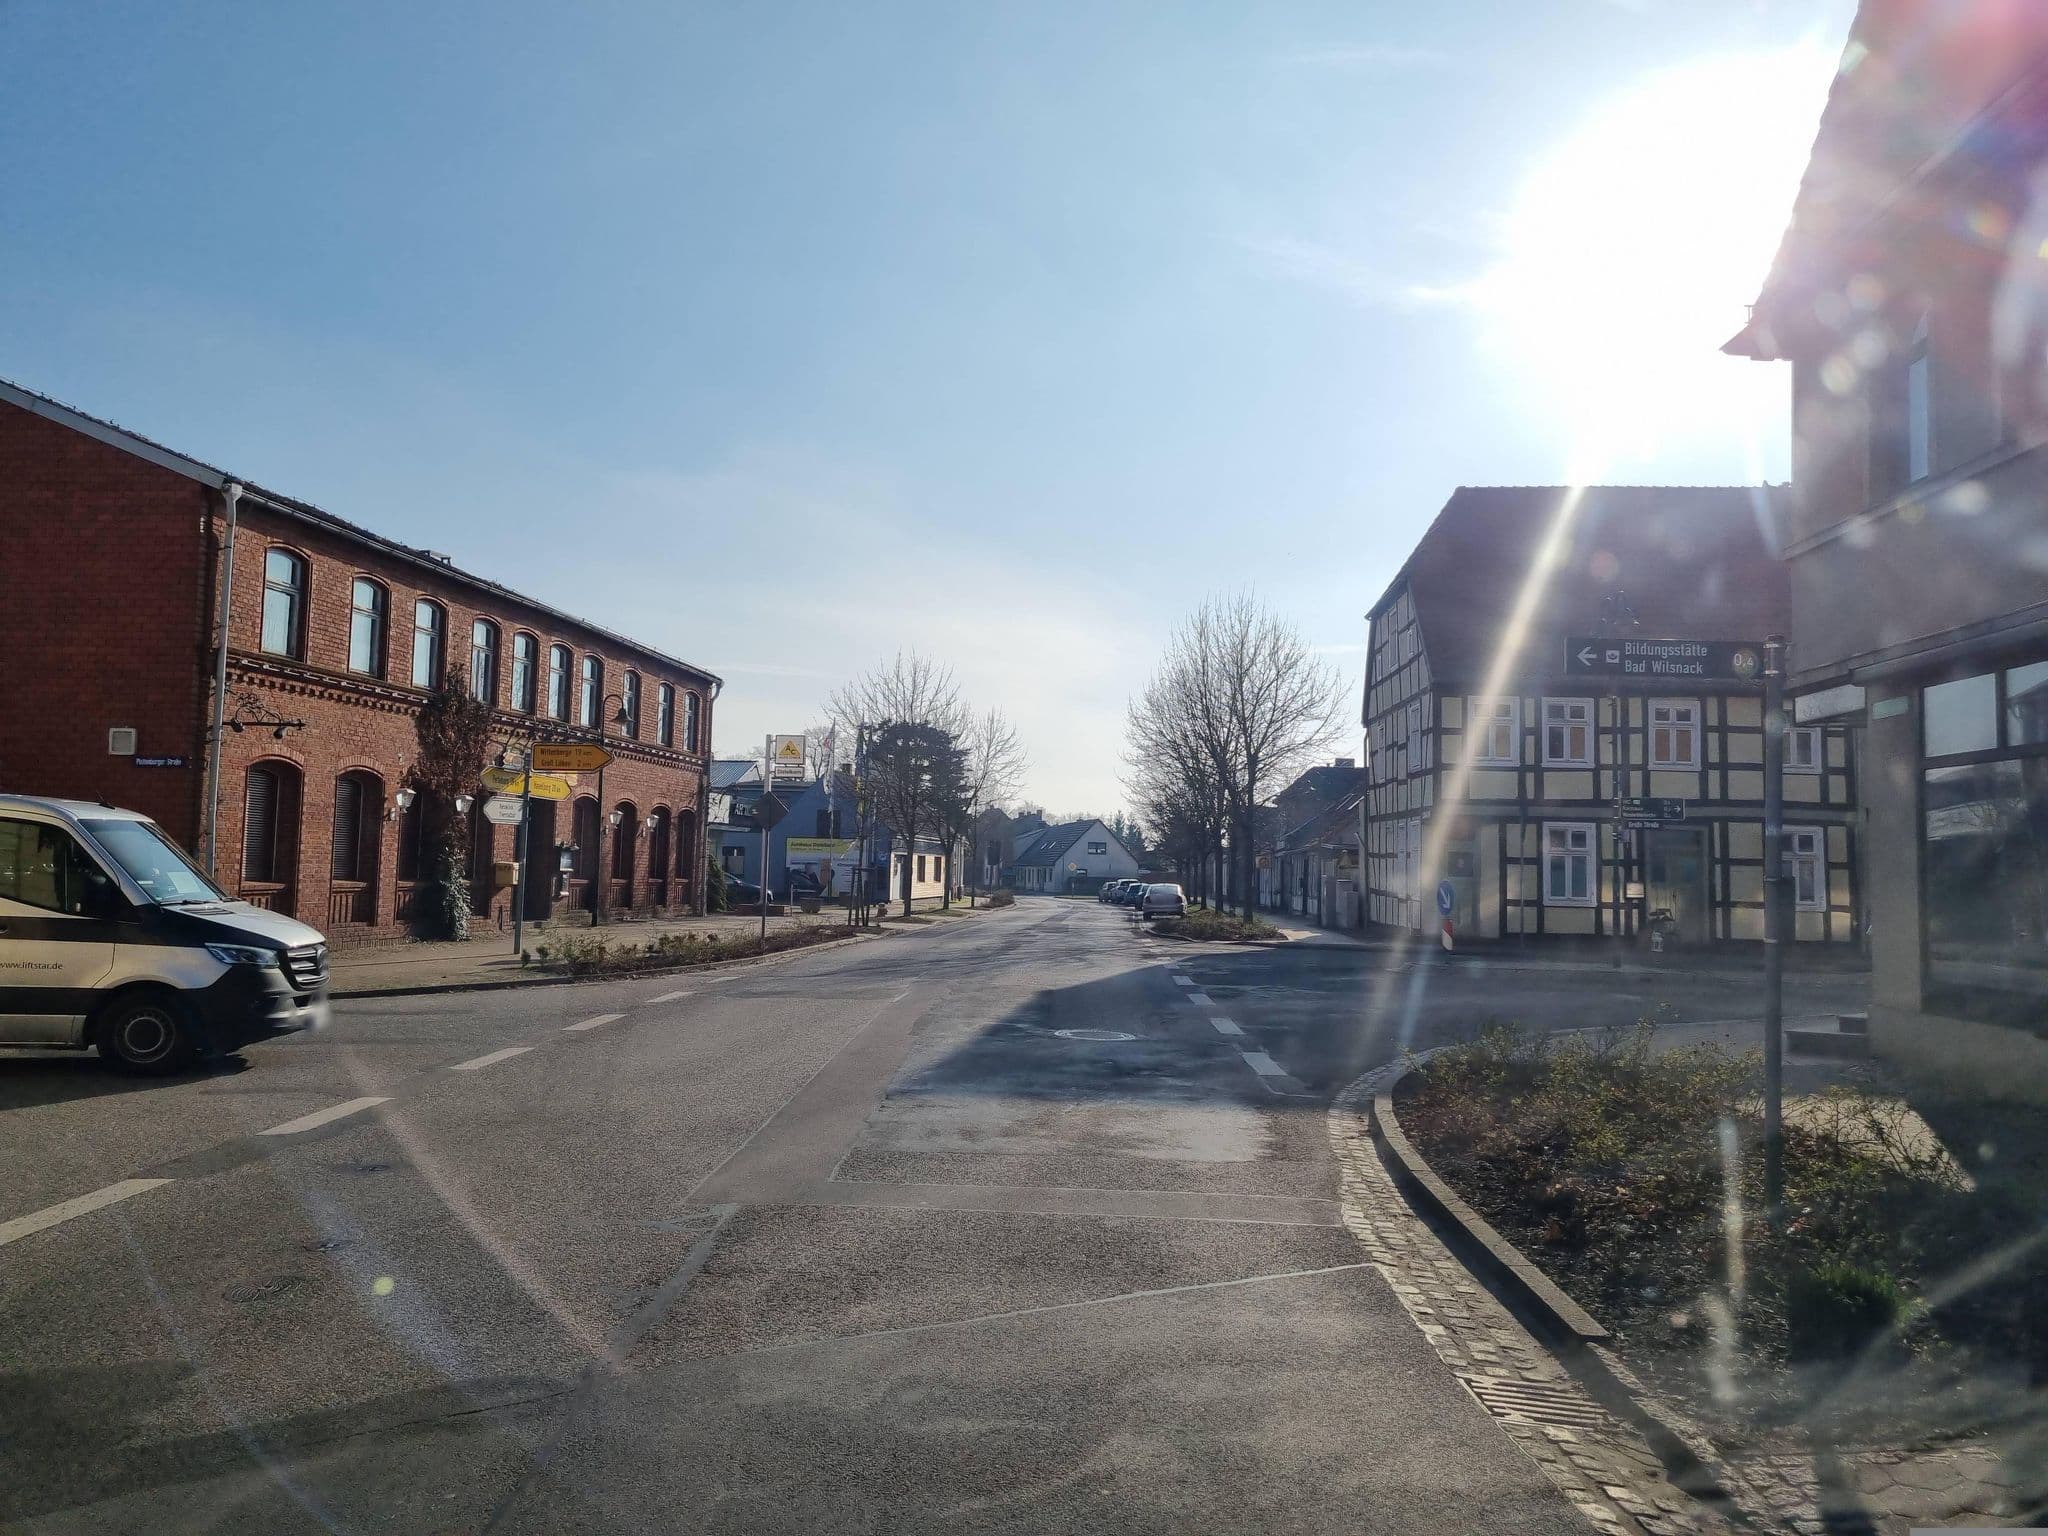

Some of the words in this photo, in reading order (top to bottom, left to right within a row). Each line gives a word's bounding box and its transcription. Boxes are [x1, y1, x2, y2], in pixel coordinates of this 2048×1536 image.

[1624, 642, 1708, 659] Bildungsstätte
[1734, 653, 1753, 667] 0,4
[1624, 661, 1646, 673] Bad
[1652, 661, 1703, 674] Wilsnack
[540, 748, 572, 757] Wittenberge
